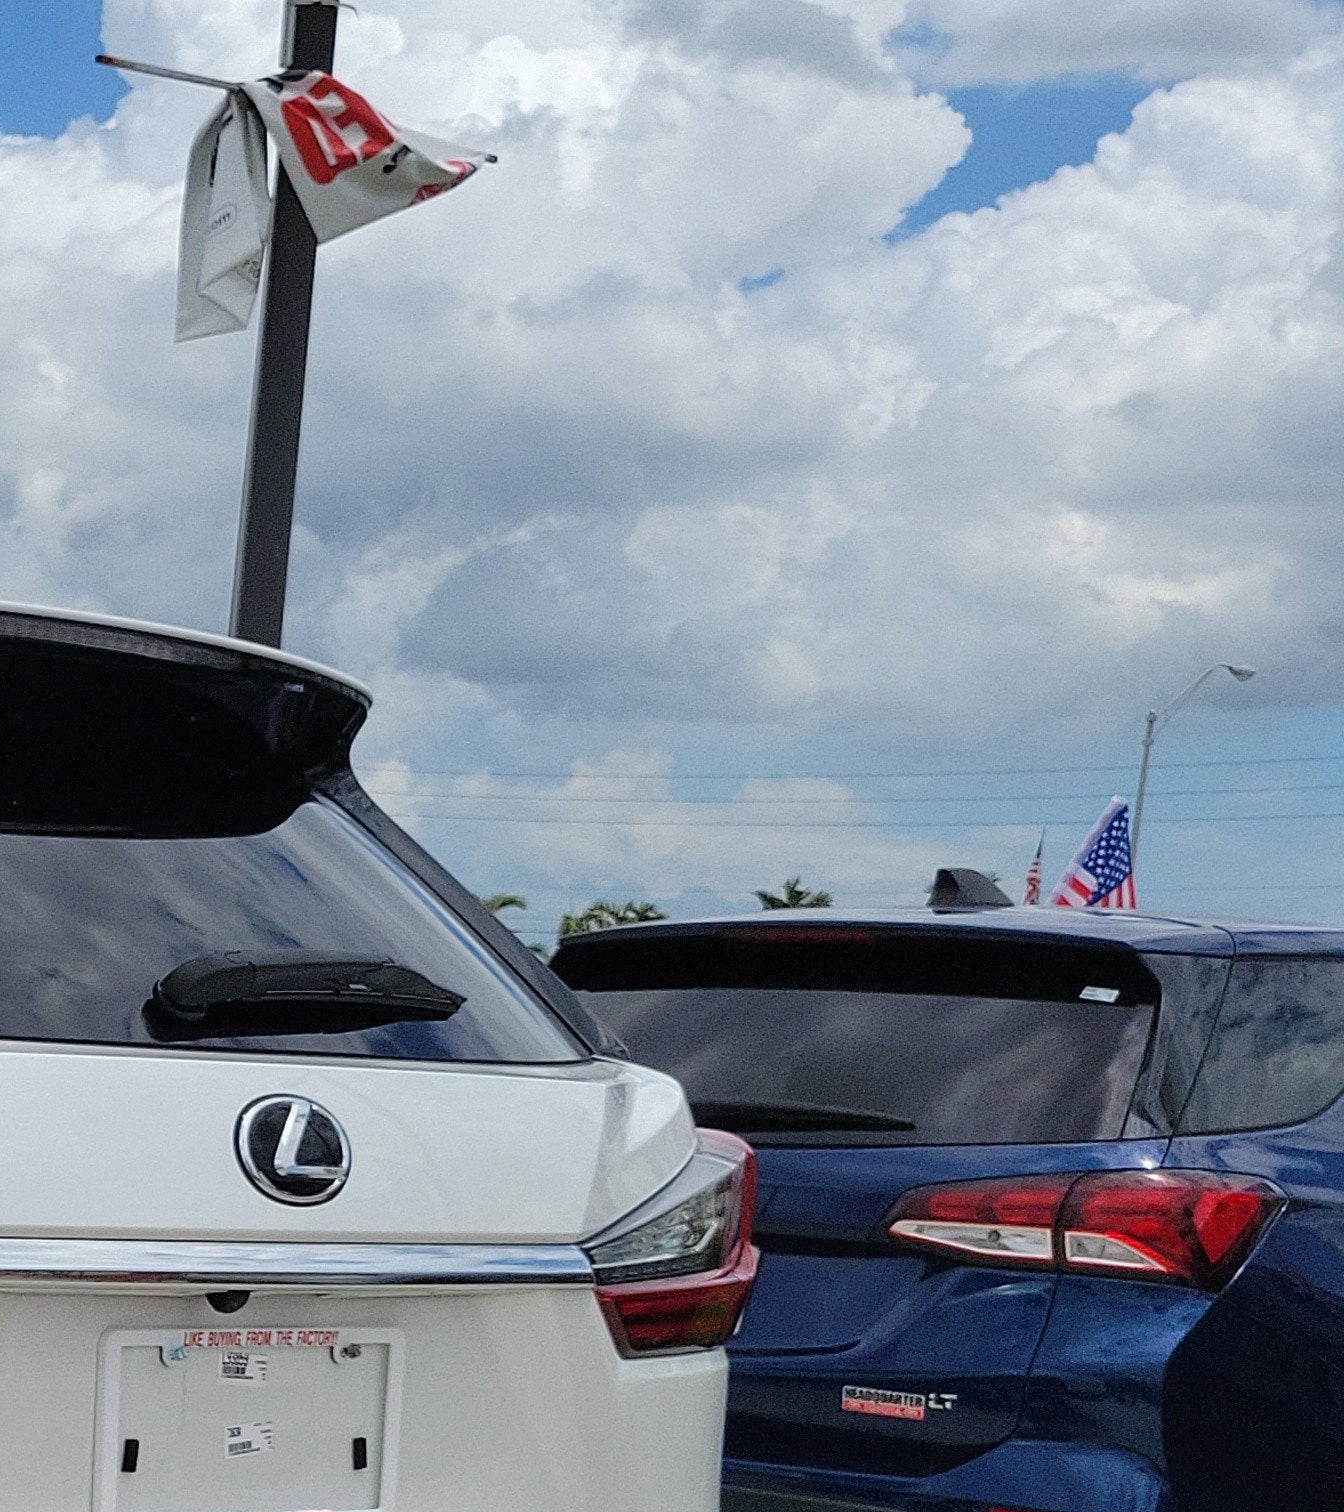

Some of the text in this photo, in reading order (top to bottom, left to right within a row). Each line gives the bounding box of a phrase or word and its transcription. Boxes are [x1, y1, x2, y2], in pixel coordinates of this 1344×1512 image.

[184, 1331, 204, 1347] LIKE
[208, 1331, 242, 1347] BUYING
[246, 1331, 272, 1346] FROM
[276, 1330, 294, 1346] THE
[928, 1392, 958, 1410] LT
